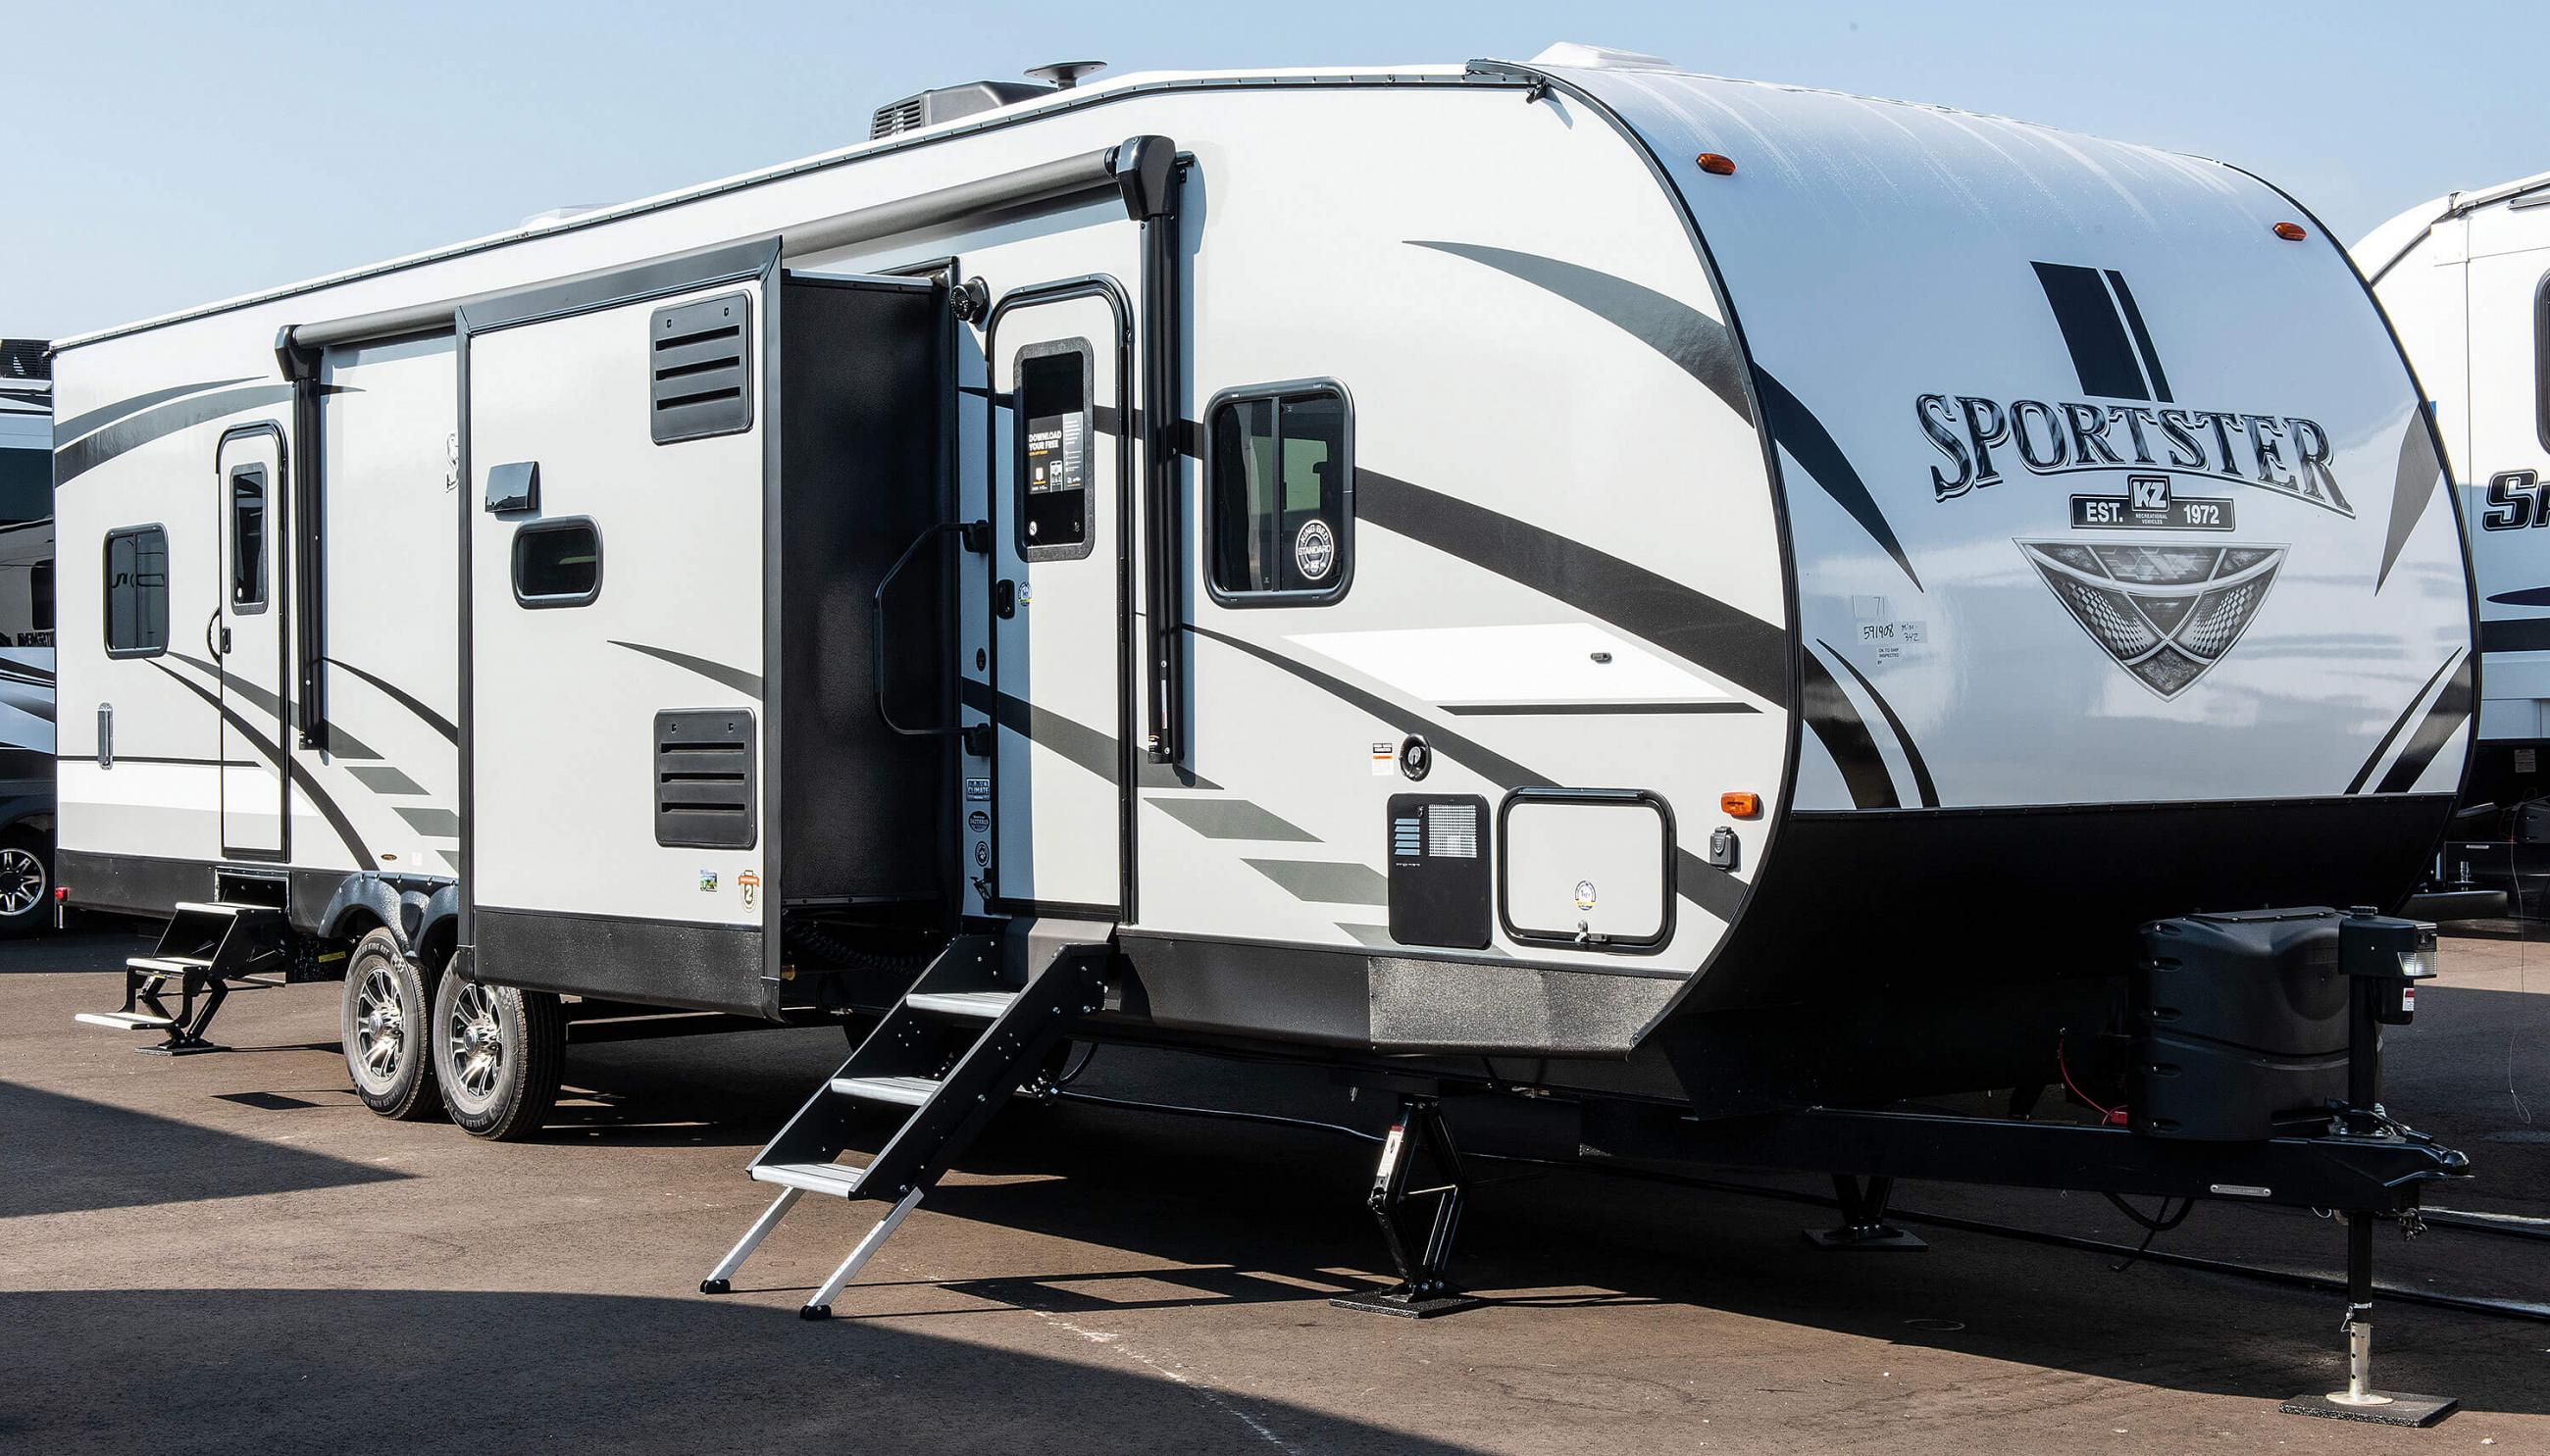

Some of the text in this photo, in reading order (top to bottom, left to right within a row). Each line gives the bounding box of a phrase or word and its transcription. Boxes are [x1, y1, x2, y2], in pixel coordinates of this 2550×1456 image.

[1029, 430, 1062, 442] DOWNLOAD
[1029, 439, 1059, 451] YOUR FREE
[1916, 393, 2354, 515] SPORTSTER
[2132, 481, 2167, 508] KZ
[2086, 502, 2220, 525] EST. 1972
[1300, 525, 1328, 543] KING BED
[1299, 545, 1331, 556] STANDARD
[1863, 623, 1894, 639] 591908
